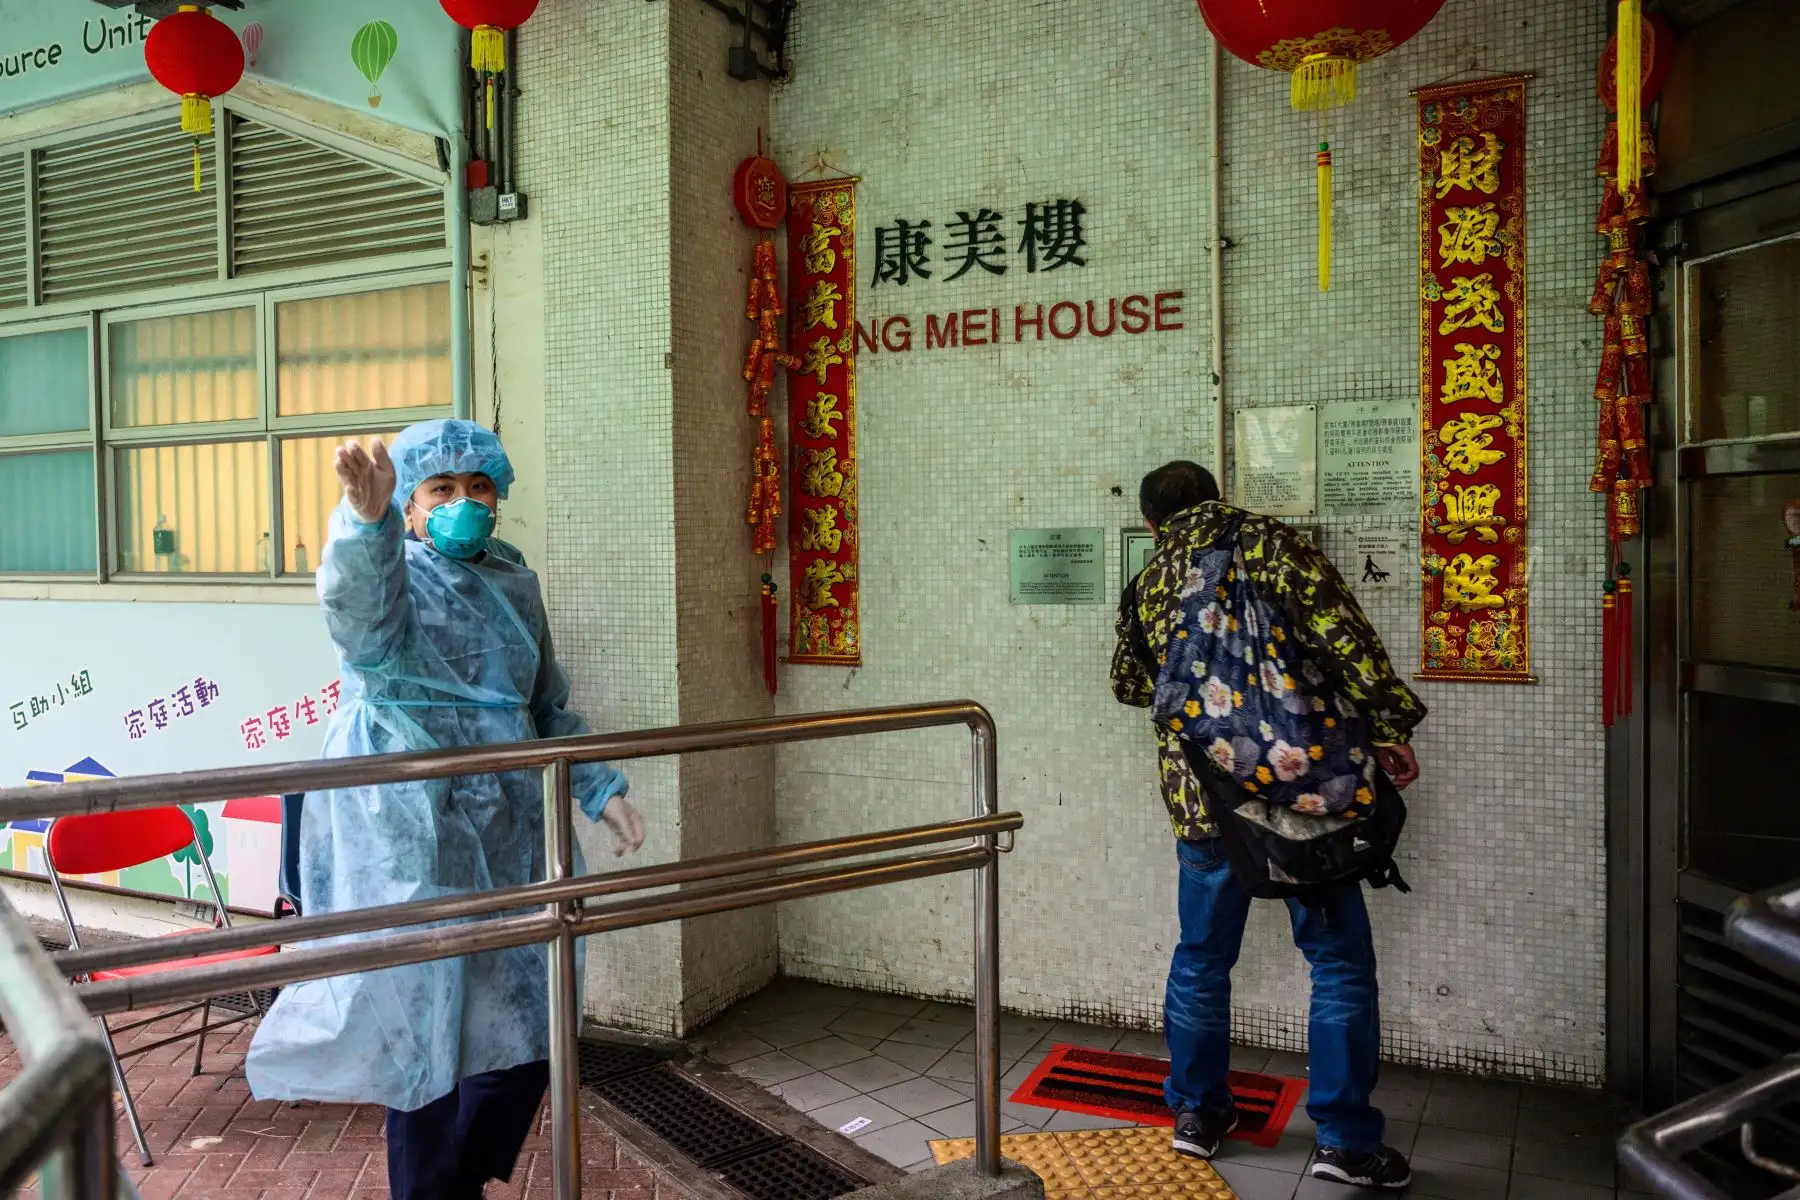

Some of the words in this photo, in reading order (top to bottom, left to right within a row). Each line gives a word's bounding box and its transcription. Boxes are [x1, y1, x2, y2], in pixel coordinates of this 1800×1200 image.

[0, 44, 62, 76] urce
[83, 14, 151, 54] Unit
[870, 198, 1087, 289] 康美樓
[926, 309, 999, 350] MEI
[1014, 290, 1185, 343] HOUSE
[801, 222, 843, 611] 富貴平安福滿堂
[1346, 460, 1390, 468] ATTENTION
[9, 669, 93, 731] 互助小組
[124, 677, 219, 740] 家庭活動
